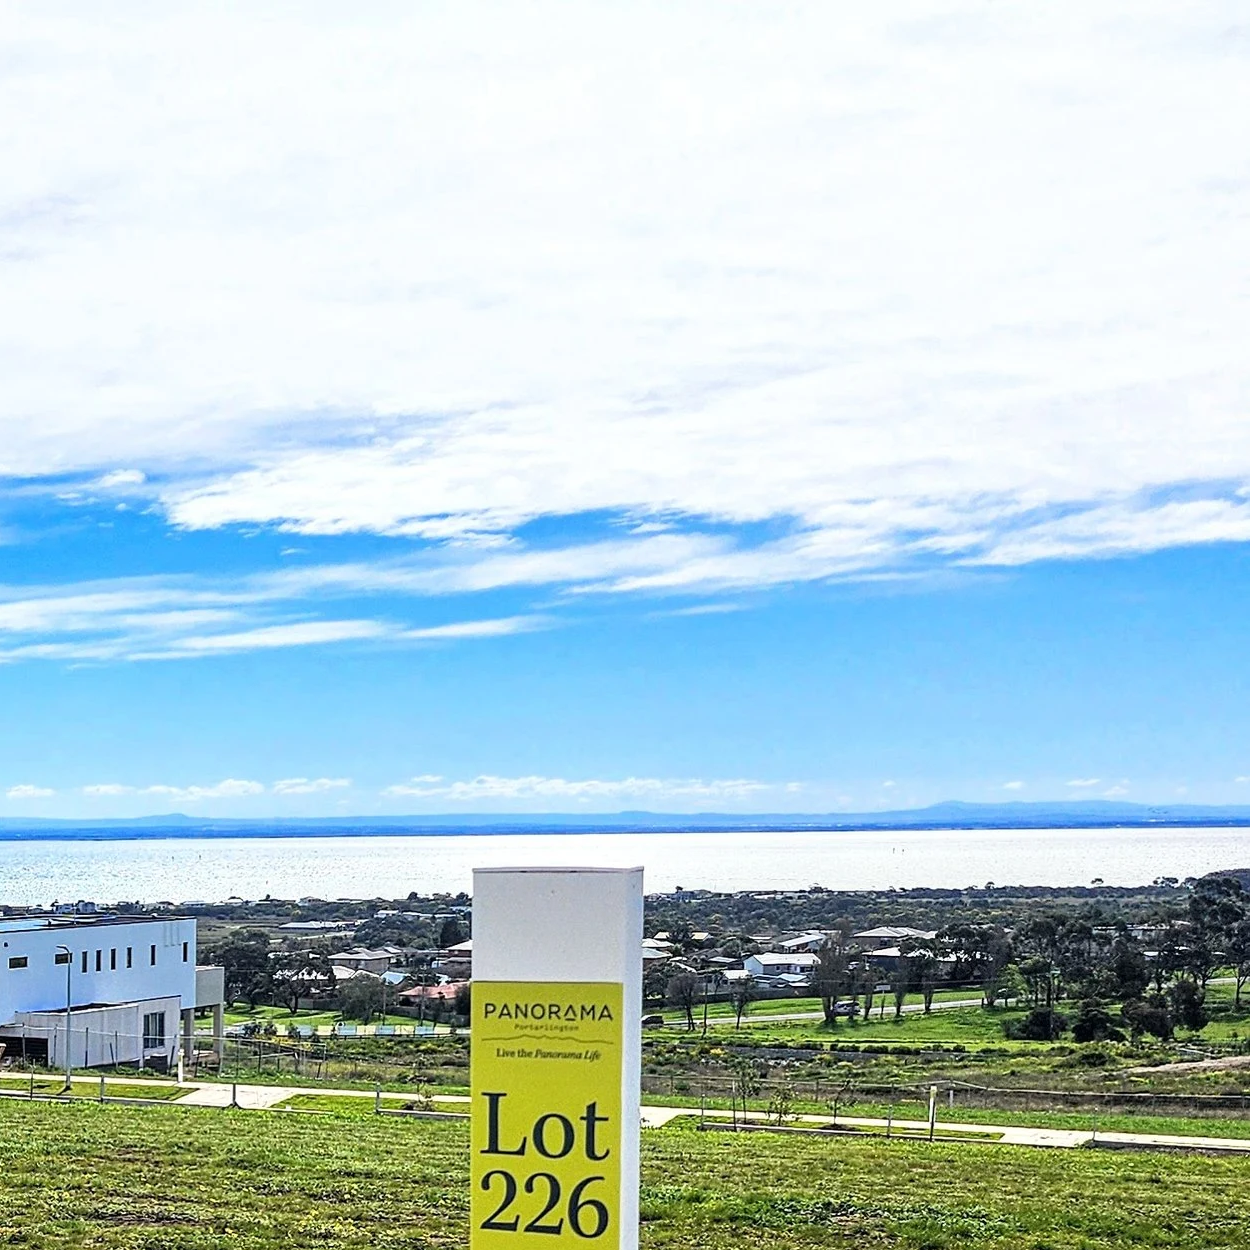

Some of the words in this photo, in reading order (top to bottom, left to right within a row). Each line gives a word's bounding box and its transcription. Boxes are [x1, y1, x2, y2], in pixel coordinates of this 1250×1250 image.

[484, 1003, 613, 1021] PANORAMA
[514, 1024, 579, 1032] Portarlington
[496, 1048, 516, 1058] Live
[517, 1049, 533, 1058] the
[534, 1049, 582, 1060] Panorama
[583, 1050, 601, 1062] Life
[480, 1092, 610, 1161] Lot
[480, 1170, 609, 1239] 226
